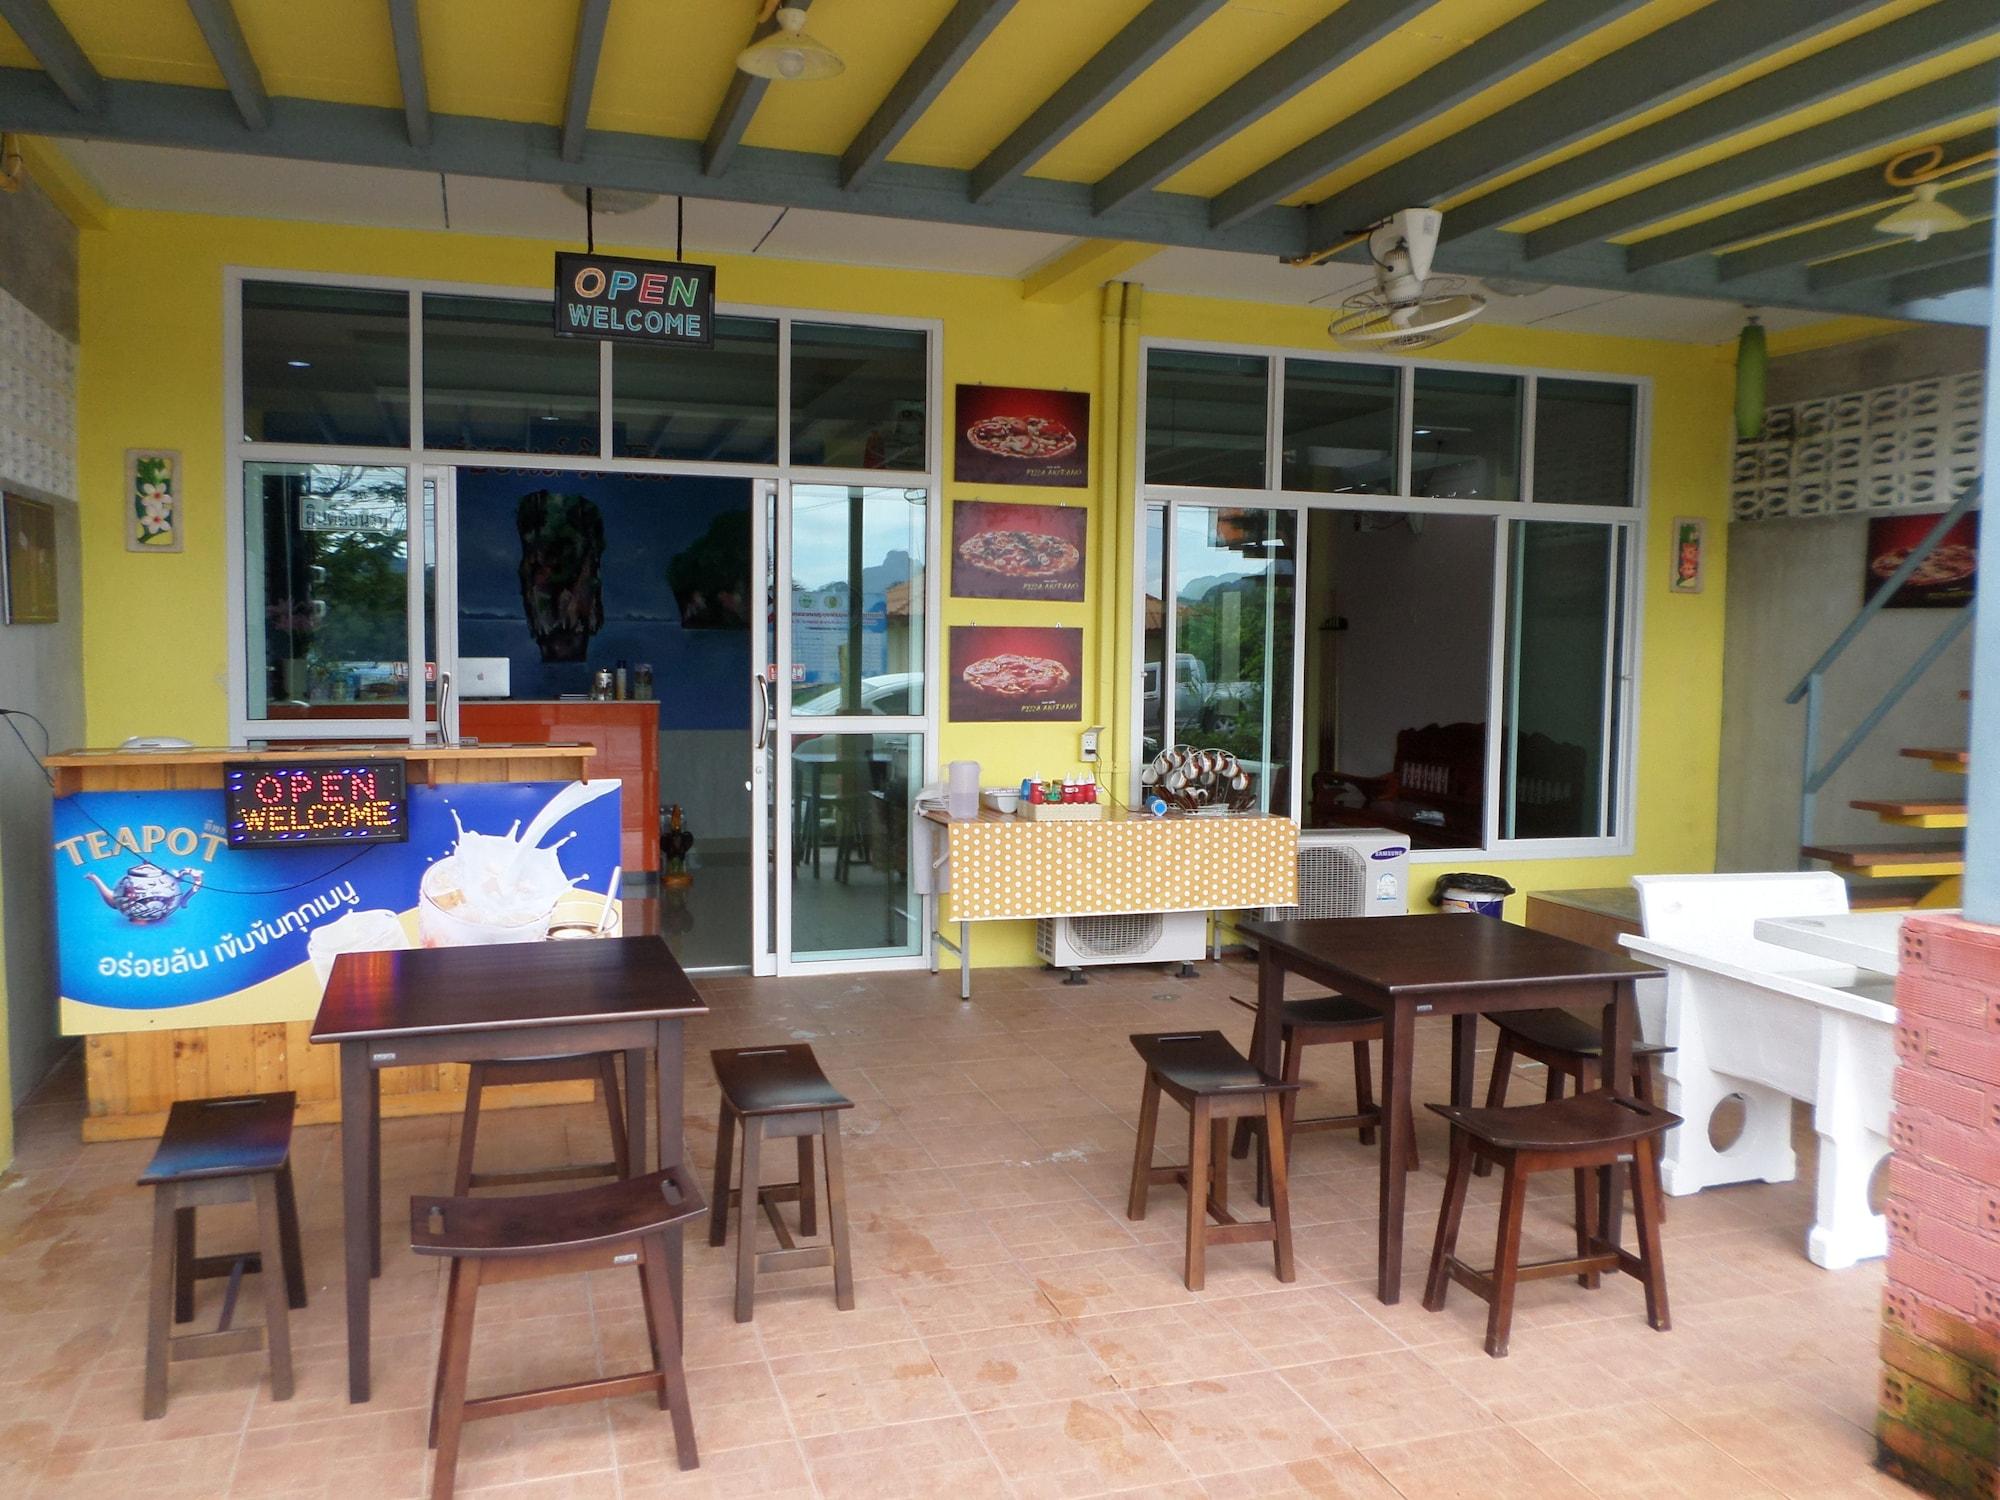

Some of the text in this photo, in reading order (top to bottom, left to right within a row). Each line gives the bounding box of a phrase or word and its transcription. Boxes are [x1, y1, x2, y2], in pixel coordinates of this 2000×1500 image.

[574, 267, 699, 308] OPEN
[568, 303, 701, 337] WELCOME
[255, 772, 377, 804] OPEN
[240, 800, 393, 832] WELCOME
[54, 825, 229, 867] TEAPOT
[97, 880, 360, 979] อร่อยล้น เข้มข้นทุกเมนู
